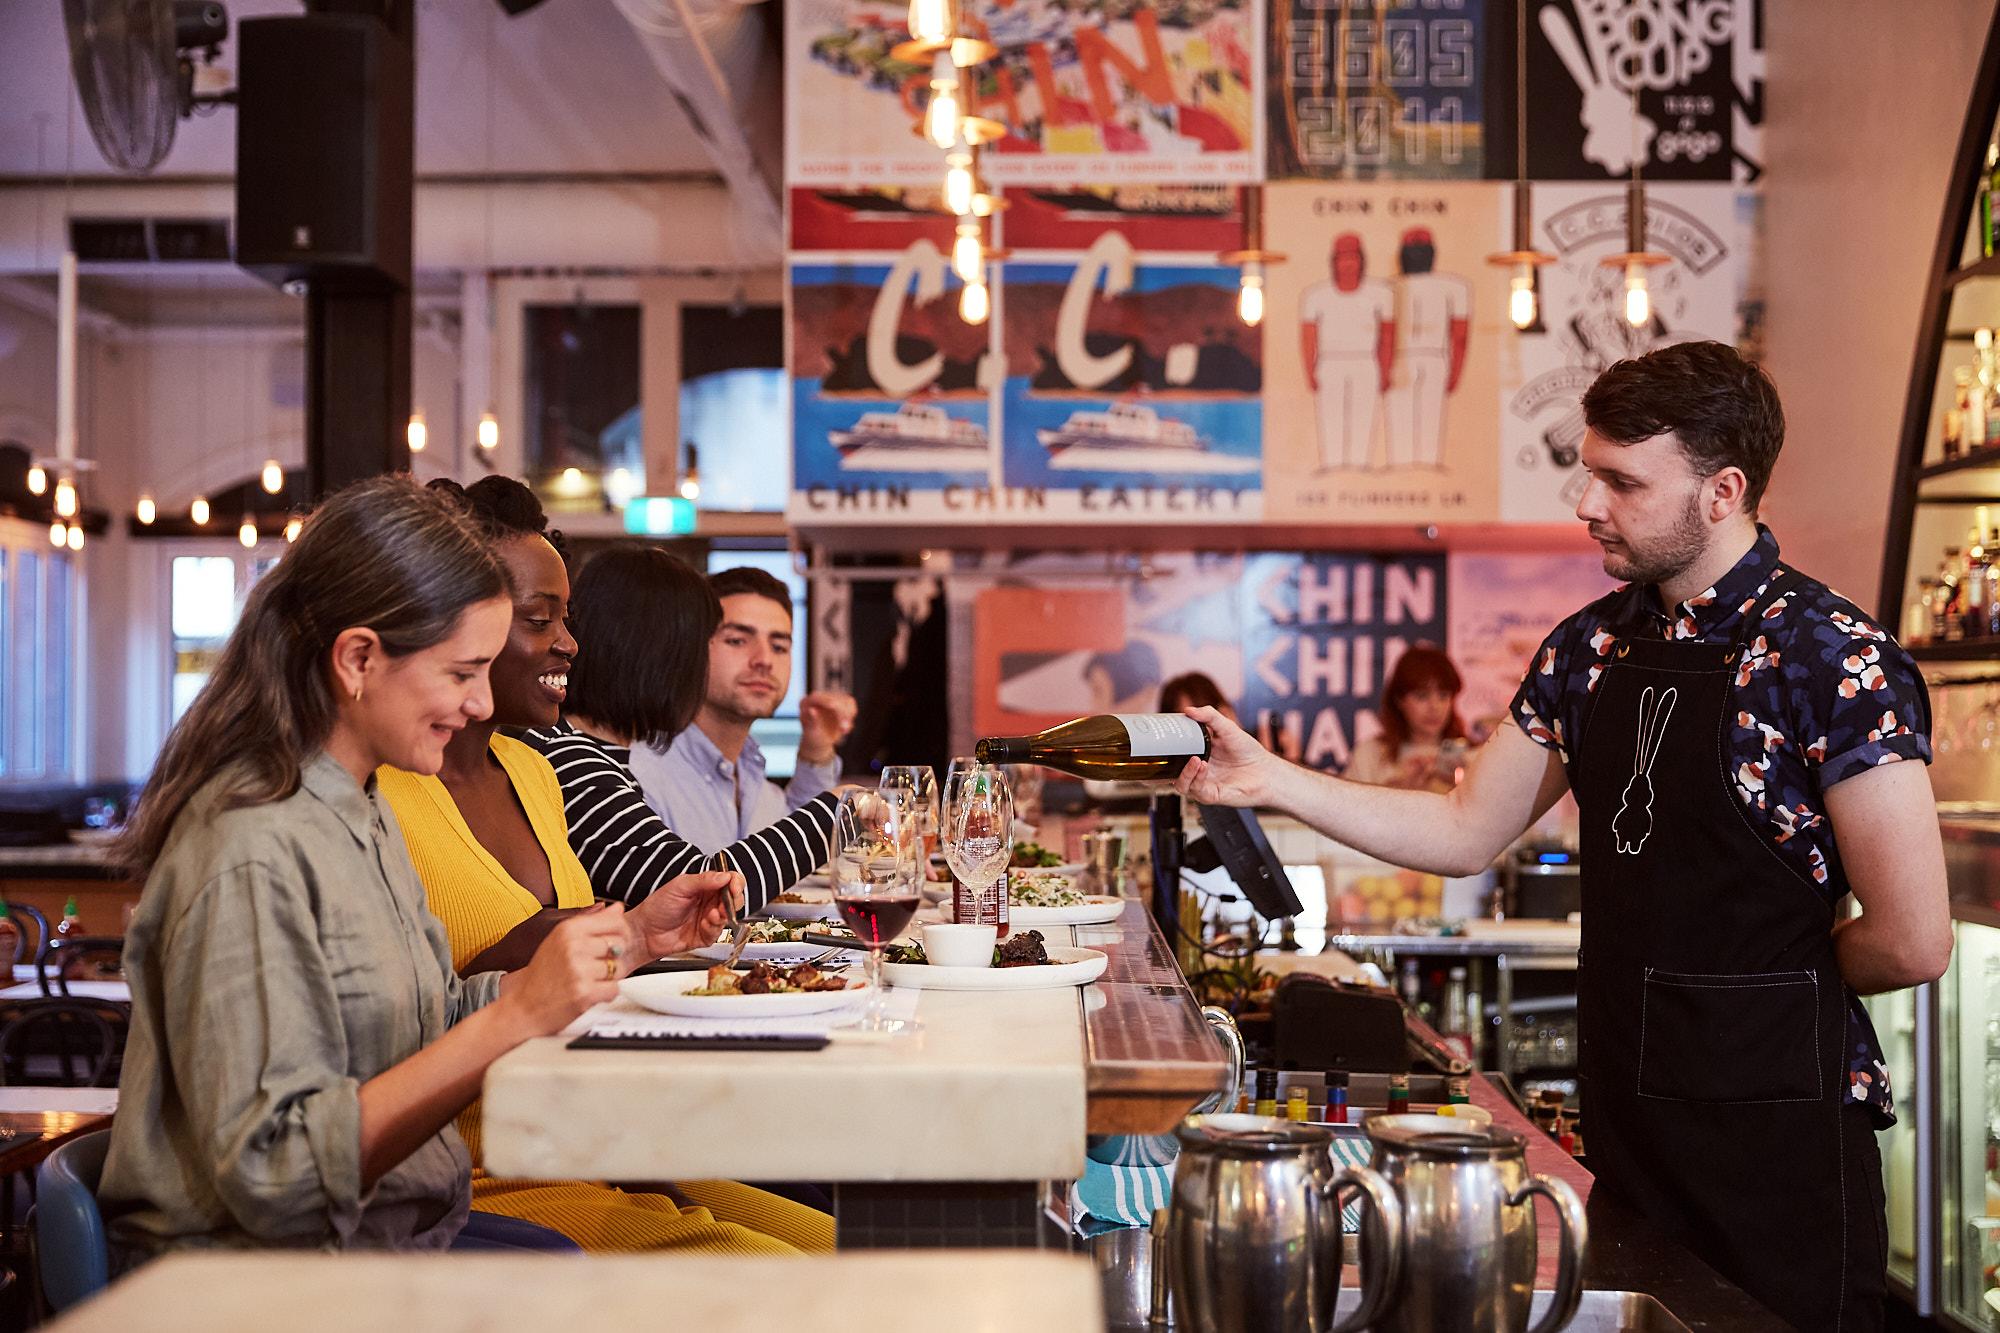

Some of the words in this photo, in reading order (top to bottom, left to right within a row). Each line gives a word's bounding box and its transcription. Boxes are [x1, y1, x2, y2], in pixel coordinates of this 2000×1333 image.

[1612, 41, 1714, 90] CUP
[1297, 96, 1463, 165] 2011
[807, 485, 910, 511] CHIN
[943, 485, 1047, 511] CHIN
[1079, 485, 1244, 511] EATERY
